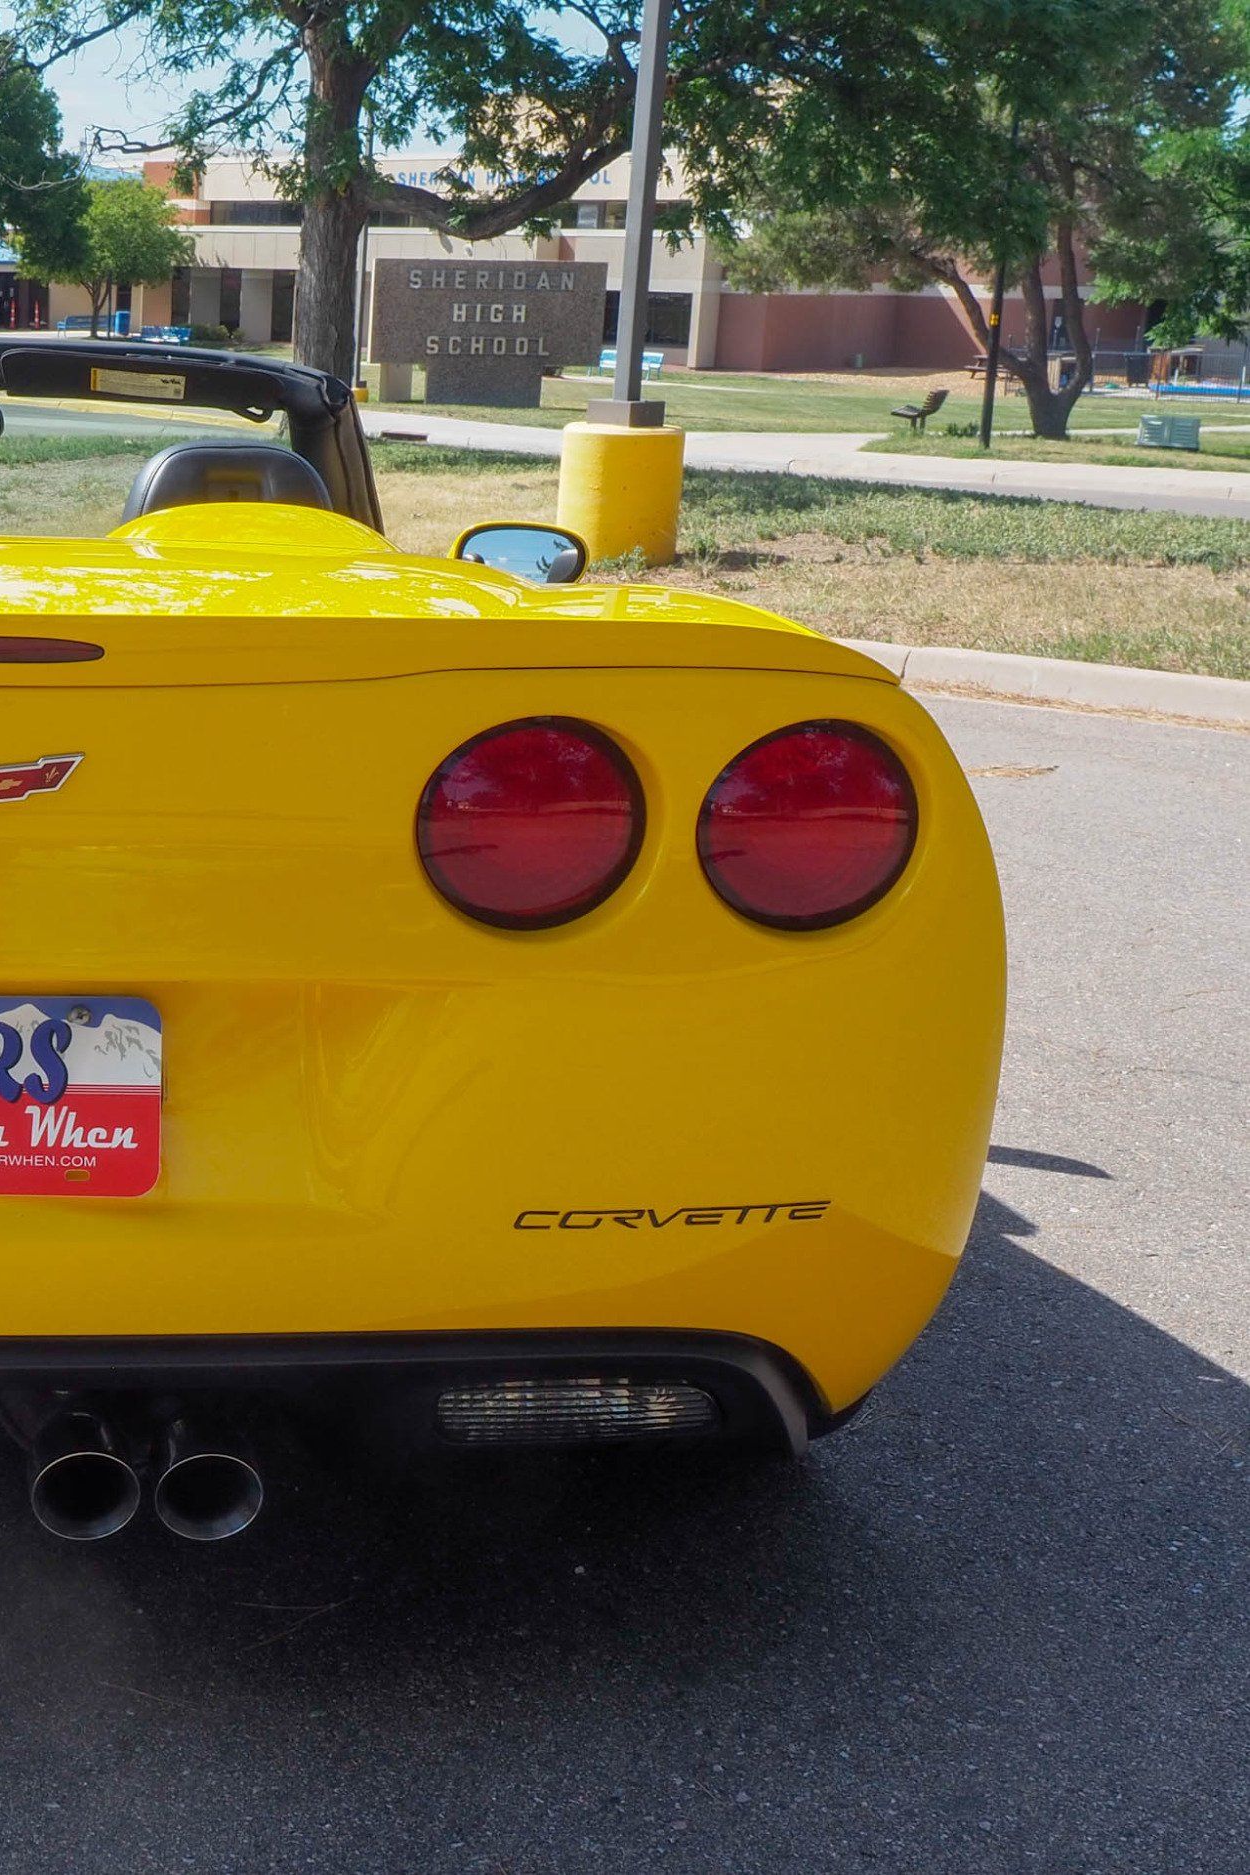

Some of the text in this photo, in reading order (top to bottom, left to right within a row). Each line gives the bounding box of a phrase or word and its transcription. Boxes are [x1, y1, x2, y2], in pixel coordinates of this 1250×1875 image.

[398, 171, 475, 187] SHERN
[409, 269, 575, 290] SHERIDAN
[452, 303, 526, 323] HIGH
[425, 335, 550, 356] SCHOOL
[25, 1105, 138, 1149] When
[514, 1200, 832, 1230] CORVETTE
